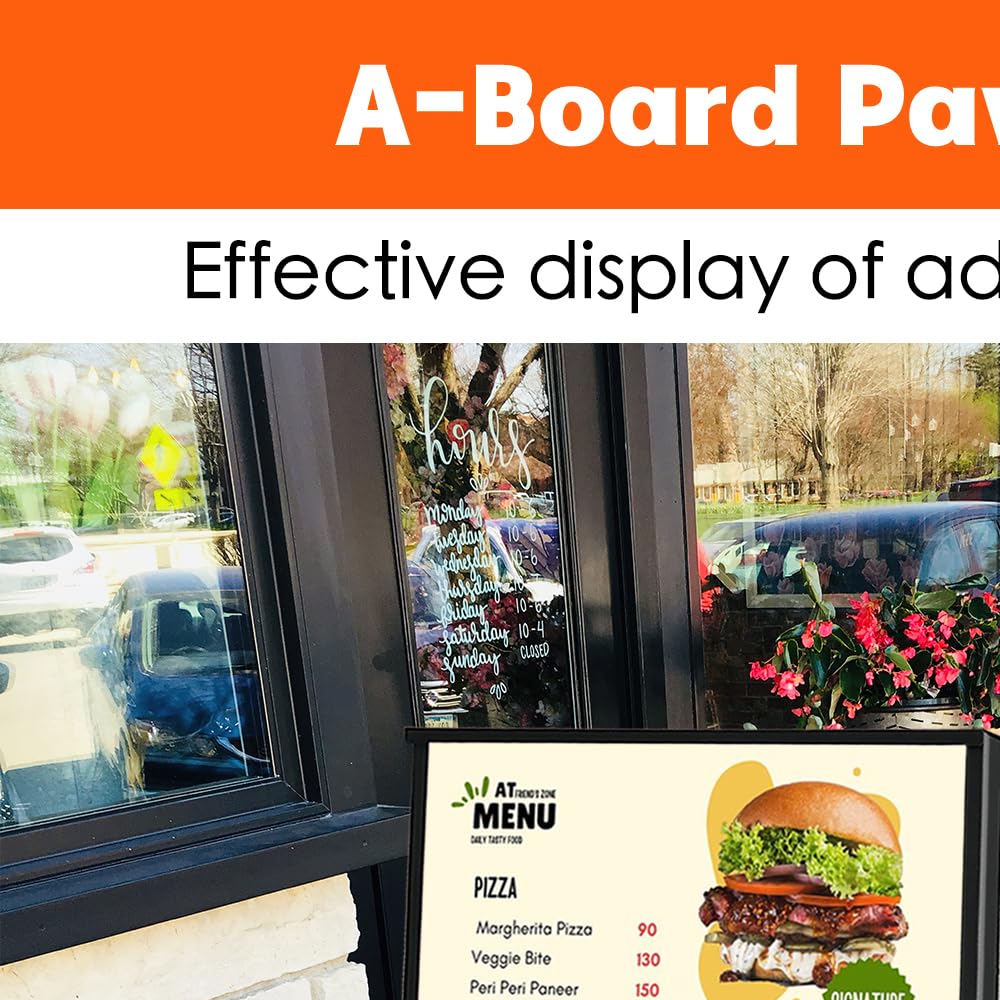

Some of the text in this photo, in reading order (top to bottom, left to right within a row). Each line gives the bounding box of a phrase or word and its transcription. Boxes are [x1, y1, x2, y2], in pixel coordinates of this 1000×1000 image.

[520, 642, 550, 659] CLOSED
[495, 782, 516, 798] AT
[473, 803, 556, 830] MENU
[470, 835, 523, 845] DAILY TASTY FOOD
[474, 876, 517, 898] PIZZA
[476, 920, 657, 939] Margherita Pizza 90
[472, 950, 660, 969] Veggie Bite 130
[470, 980, 659, 997] Peri Peri Paneer 150
